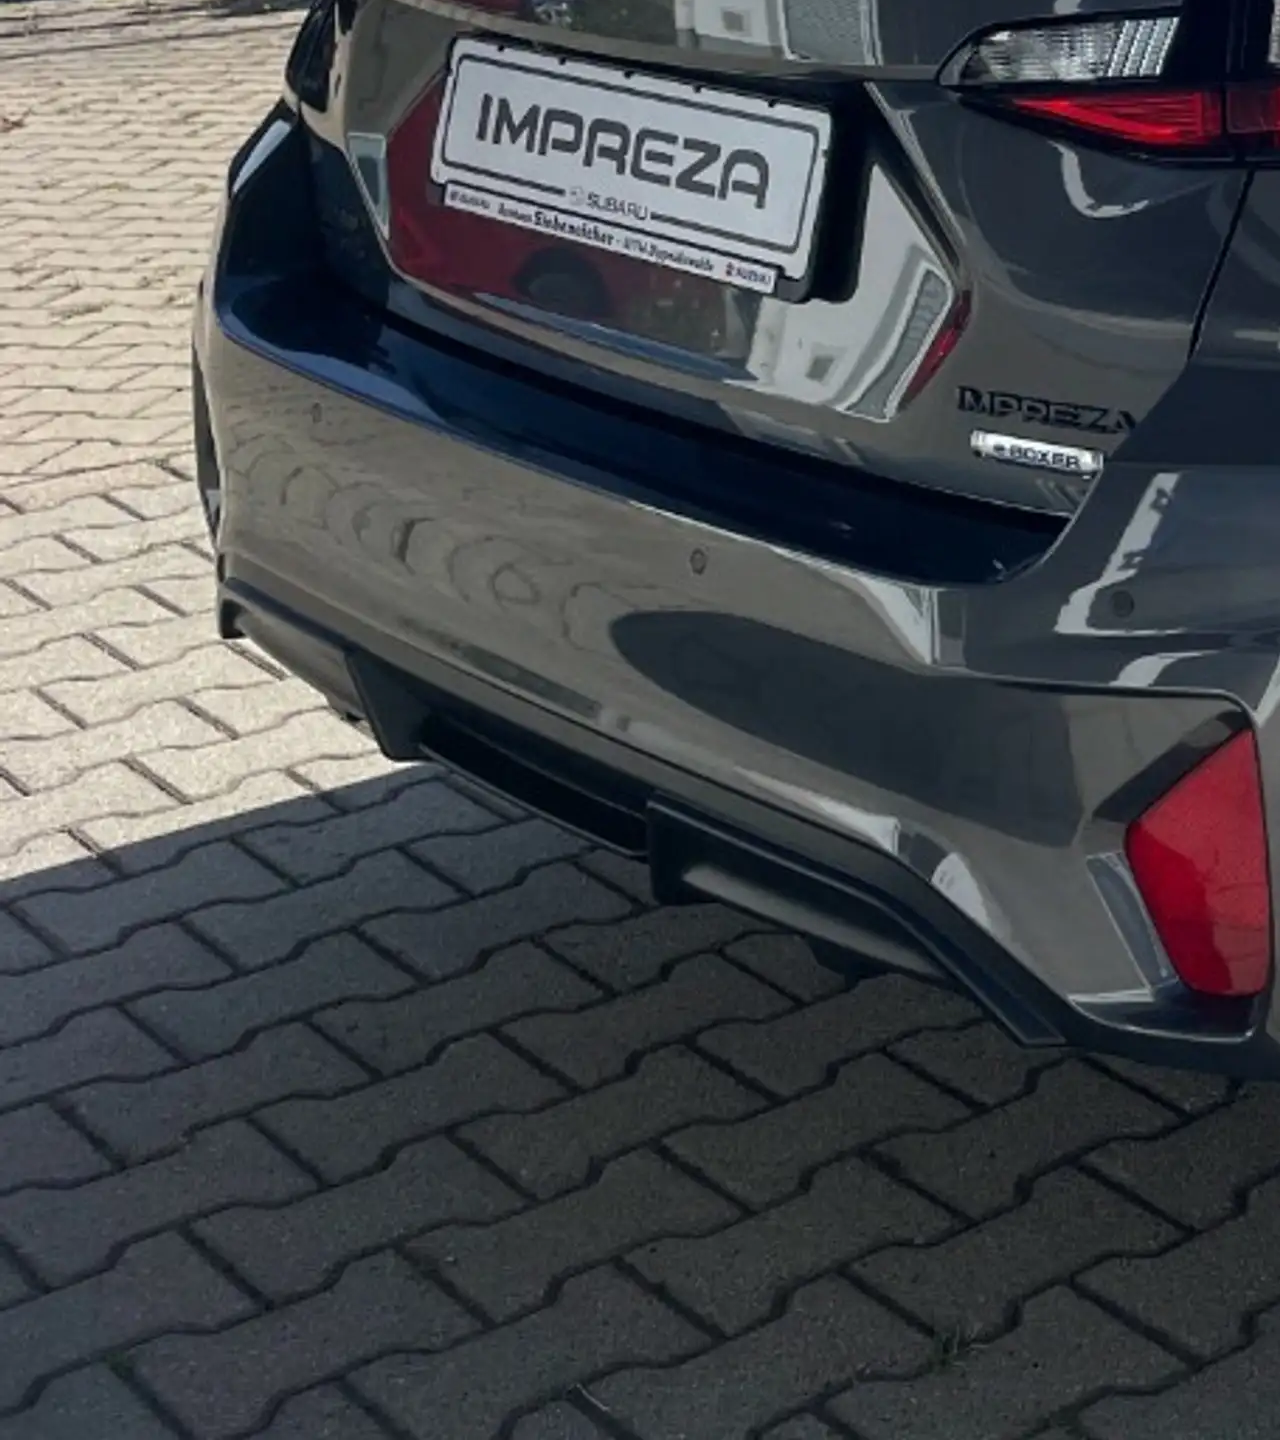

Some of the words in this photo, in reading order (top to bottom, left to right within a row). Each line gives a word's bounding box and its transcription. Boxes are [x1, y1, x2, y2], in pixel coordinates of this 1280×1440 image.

[475, 93, 770, 210] IMPREZA
[586, 190, 649, 221] SUBARU
[957, 385, 1136, 435] IMPREZA
